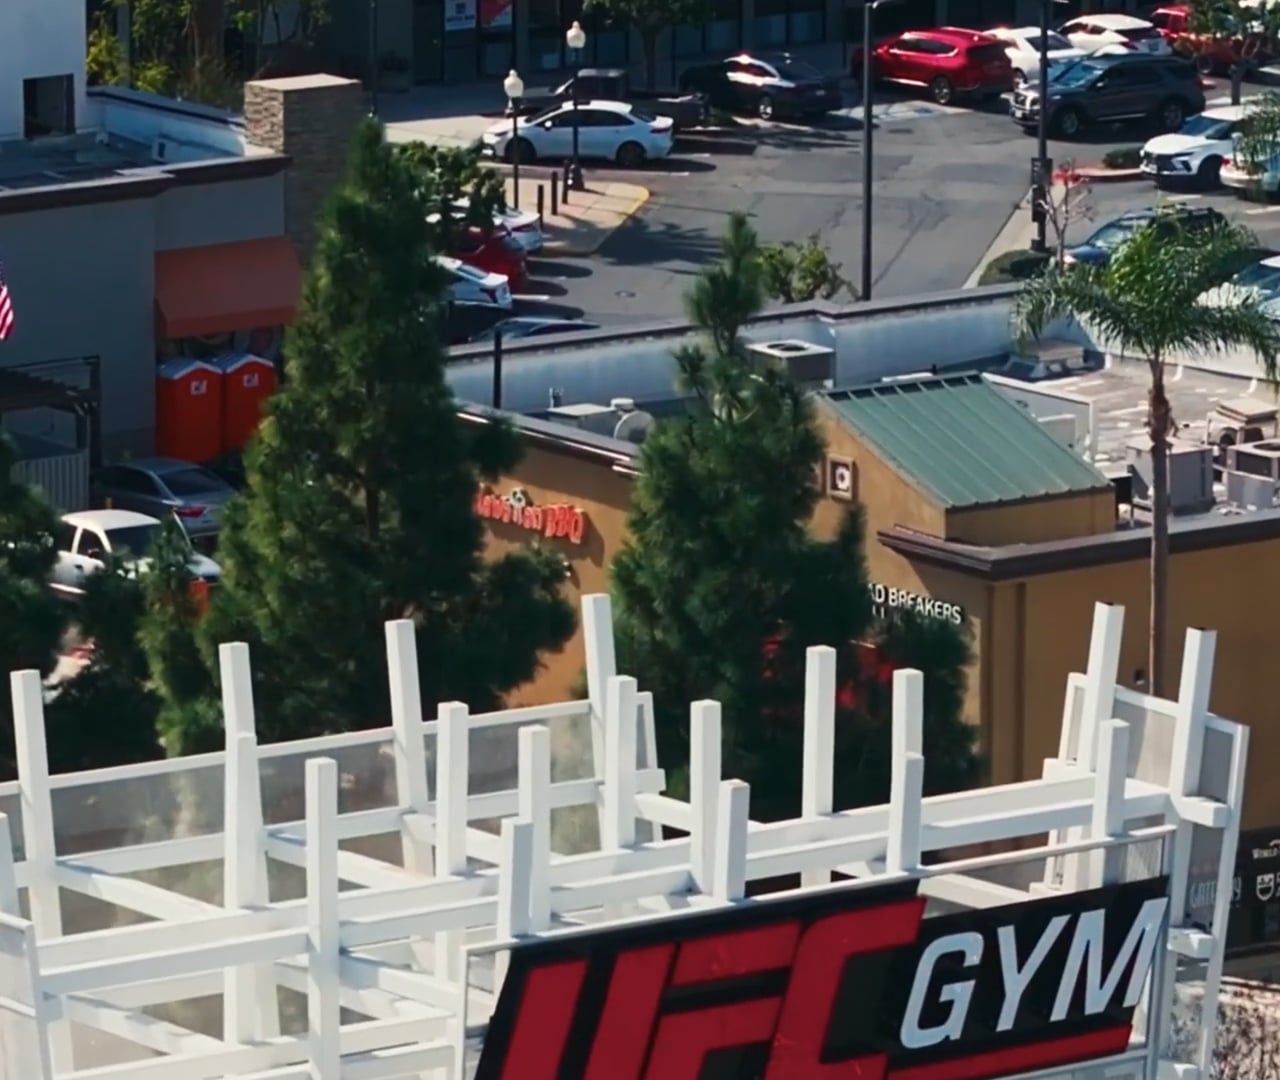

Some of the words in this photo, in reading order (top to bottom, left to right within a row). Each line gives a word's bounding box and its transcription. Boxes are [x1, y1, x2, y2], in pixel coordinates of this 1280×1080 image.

[545, 504, 584, 544] BBQ
[888, 588, 961, 624] BREAKERS
[899, 896, 1168, 1050] GYM
